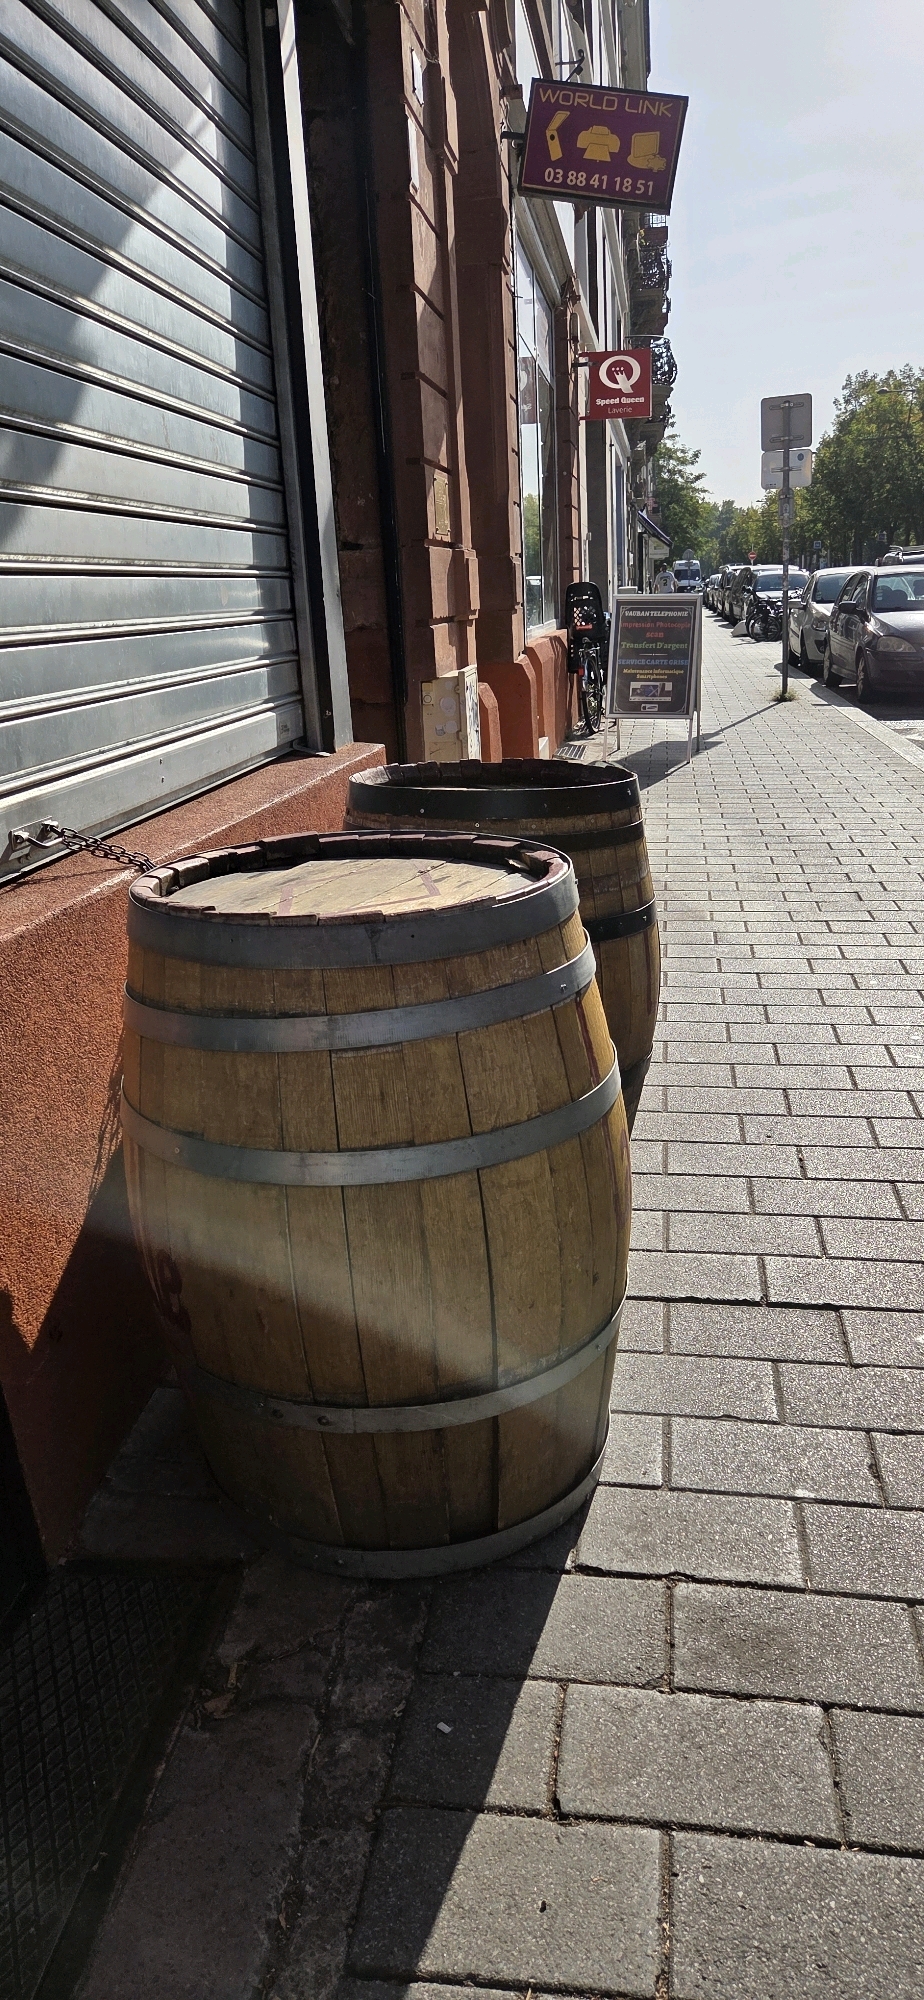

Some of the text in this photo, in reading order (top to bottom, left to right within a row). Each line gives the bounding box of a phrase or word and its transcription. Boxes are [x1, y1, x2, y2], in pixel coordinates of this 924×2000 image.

[539, 88, 673, 117] WORLD LINK
[544, 167, 653, 196] 03 88 41 18 51
[595, 396, 645, 406] Speed Queen
[607, 406, 633, 414] Laverie
[621, 641, 688, 650] Transfert D'argent
